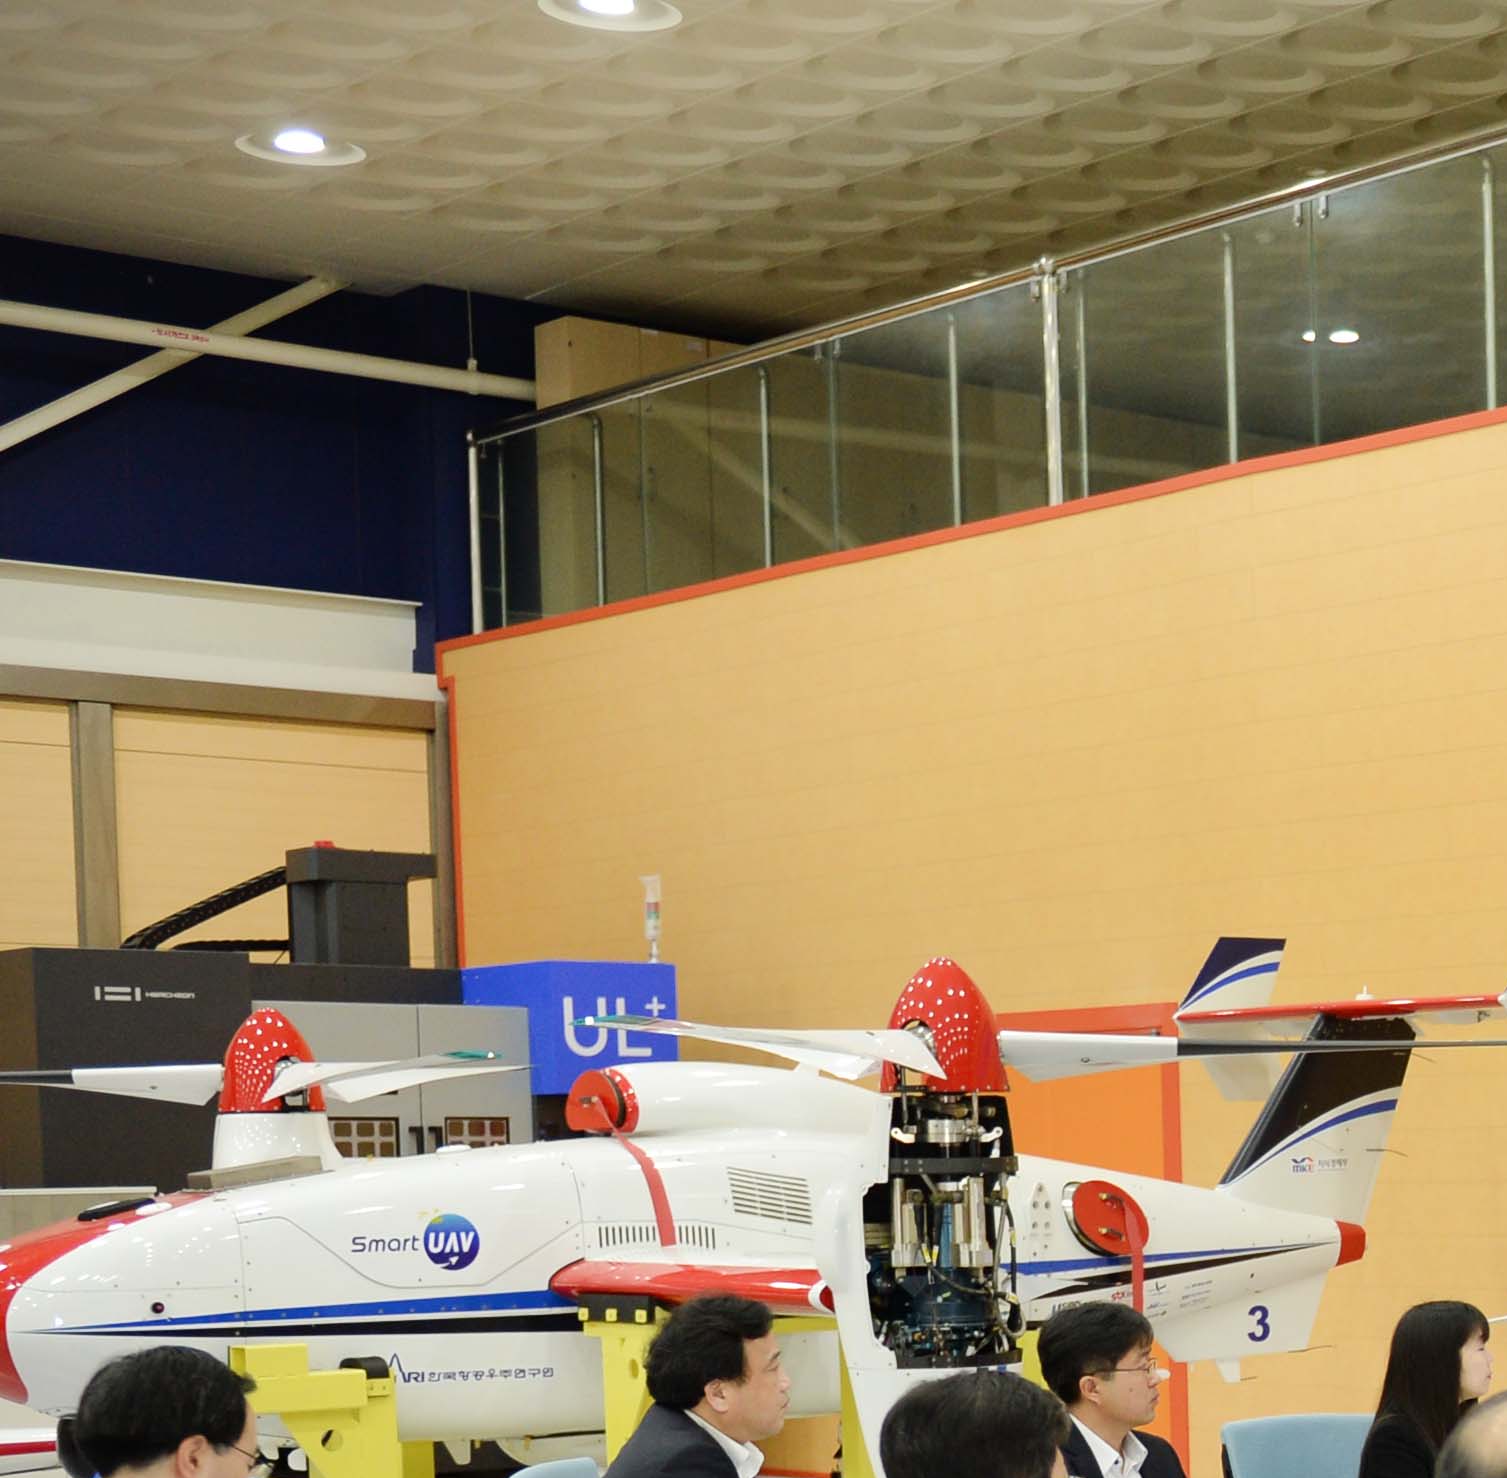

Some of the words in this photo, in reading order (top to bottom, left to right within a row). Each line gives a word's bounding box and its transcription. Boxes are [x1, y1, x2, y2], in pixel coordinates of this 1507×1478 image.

[351, 1235, 419, 1252] Smart
[428, 1231, 475, 1254] UAV
[1247, 1304, 1271, 1343] 3
[389, 1353, 425, 1383] ARI
[428, 1368, 554, 1383] 한국항공우주연구원
